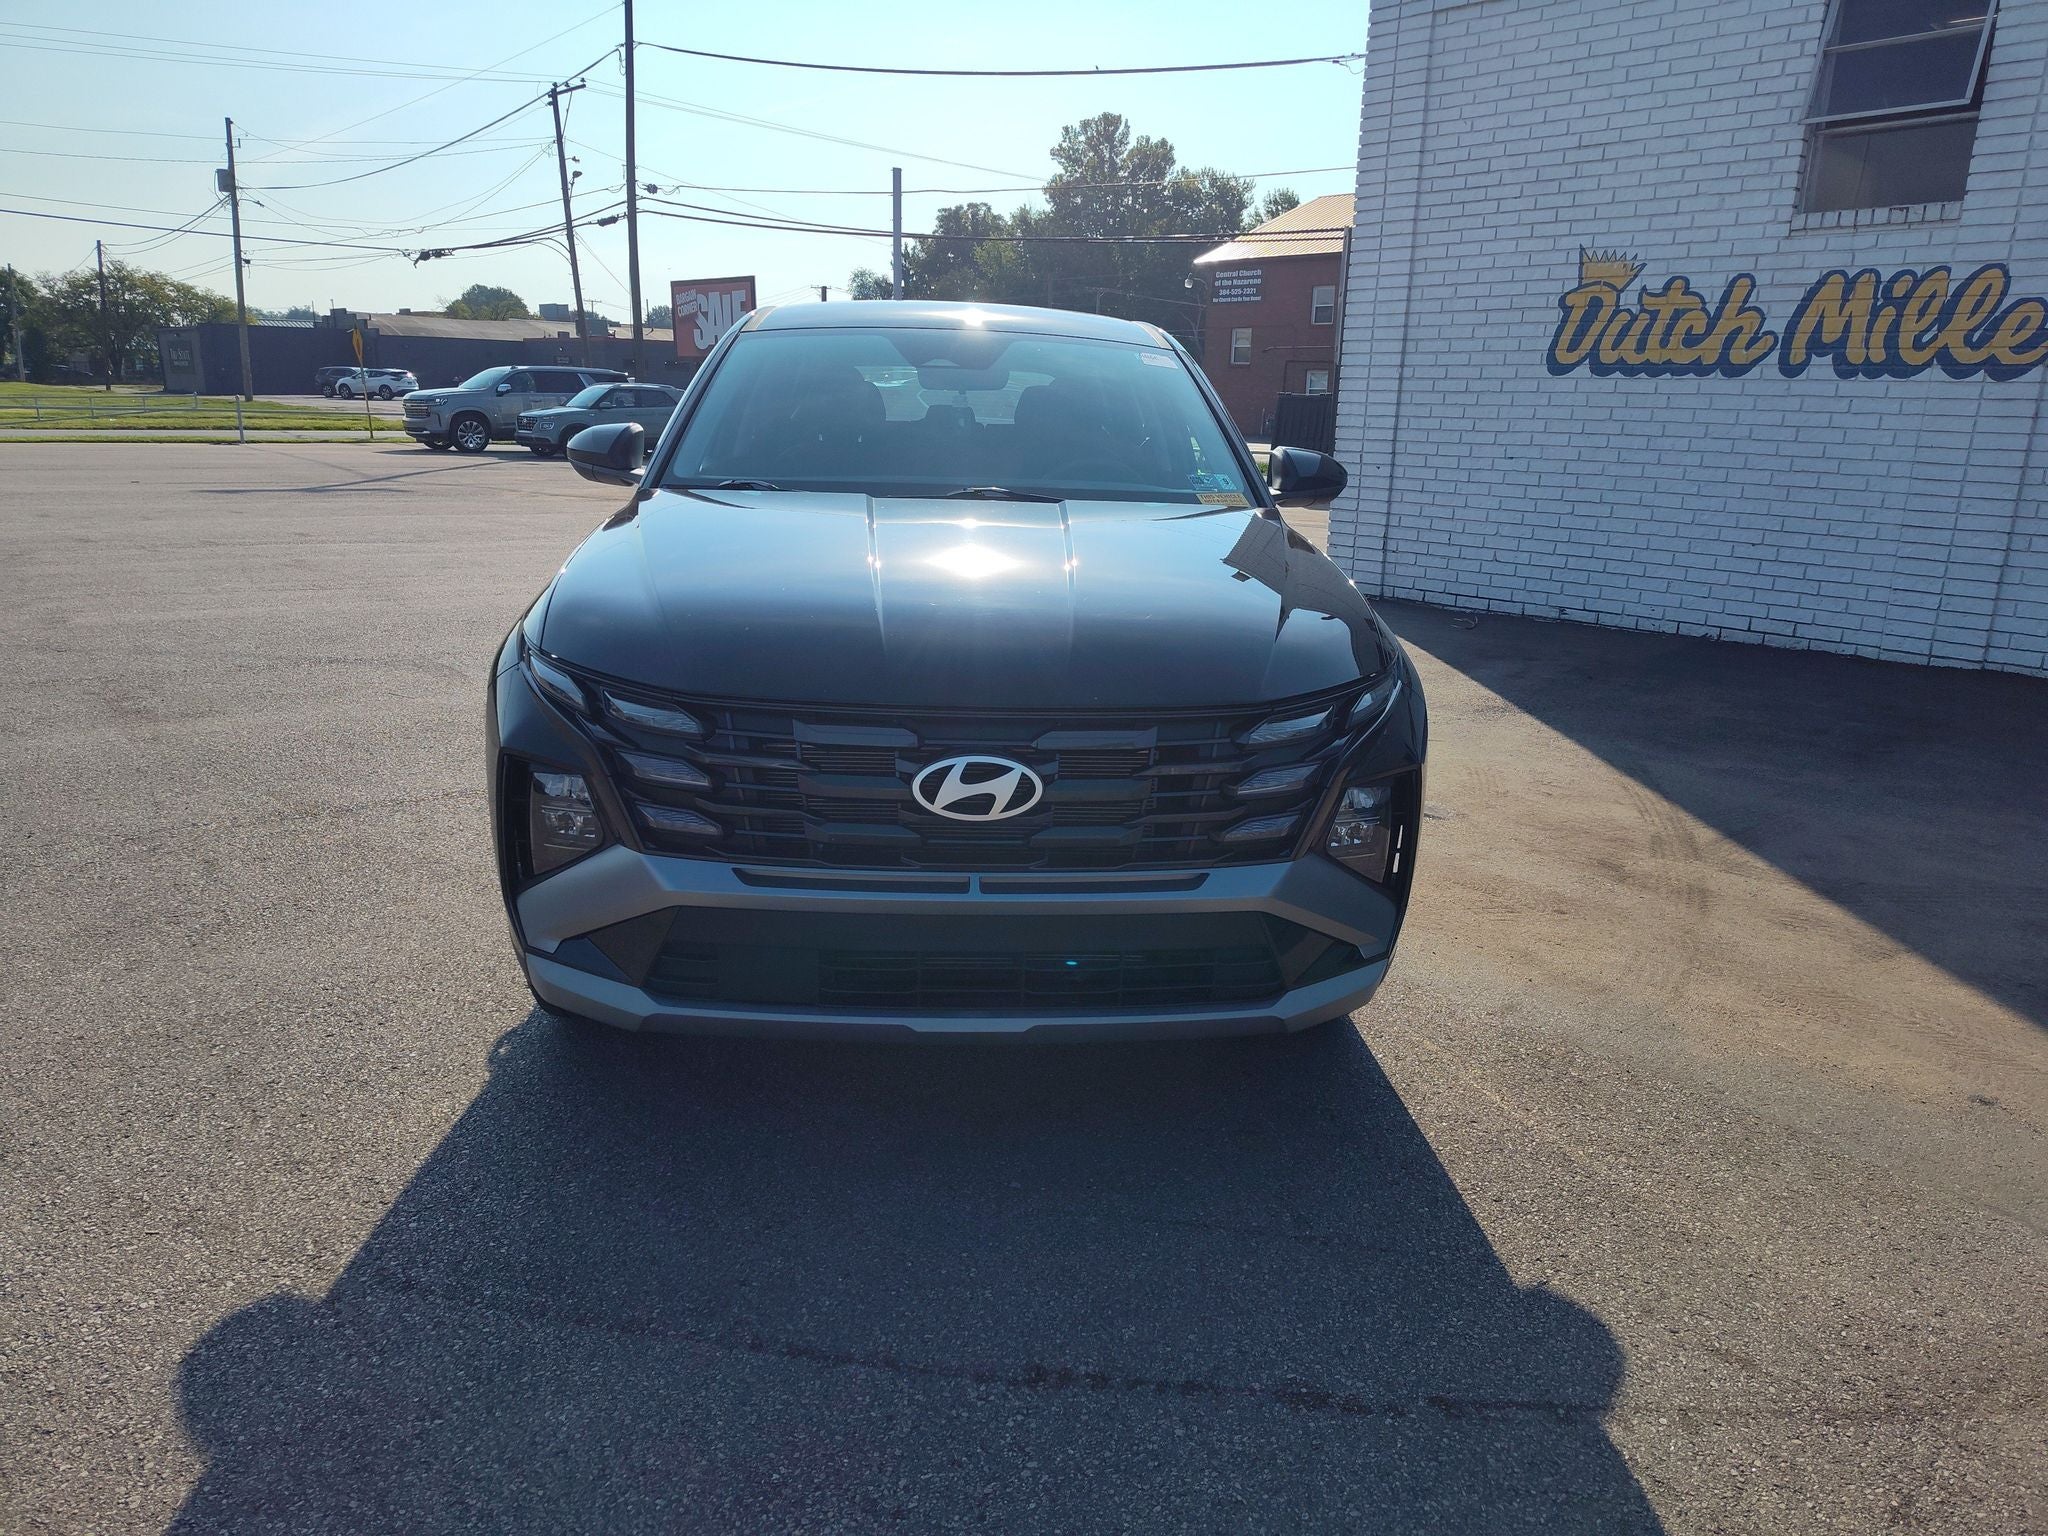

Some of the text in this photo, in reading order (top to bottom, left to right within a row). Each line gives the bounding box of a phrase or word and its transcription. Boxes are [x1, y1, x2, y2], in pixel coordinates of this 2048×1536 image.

[676, 289, 697, 304] BARGAIN
[678, 300, 698, 318] CORNER
[1546, 272, 1779, 378] Dutch
